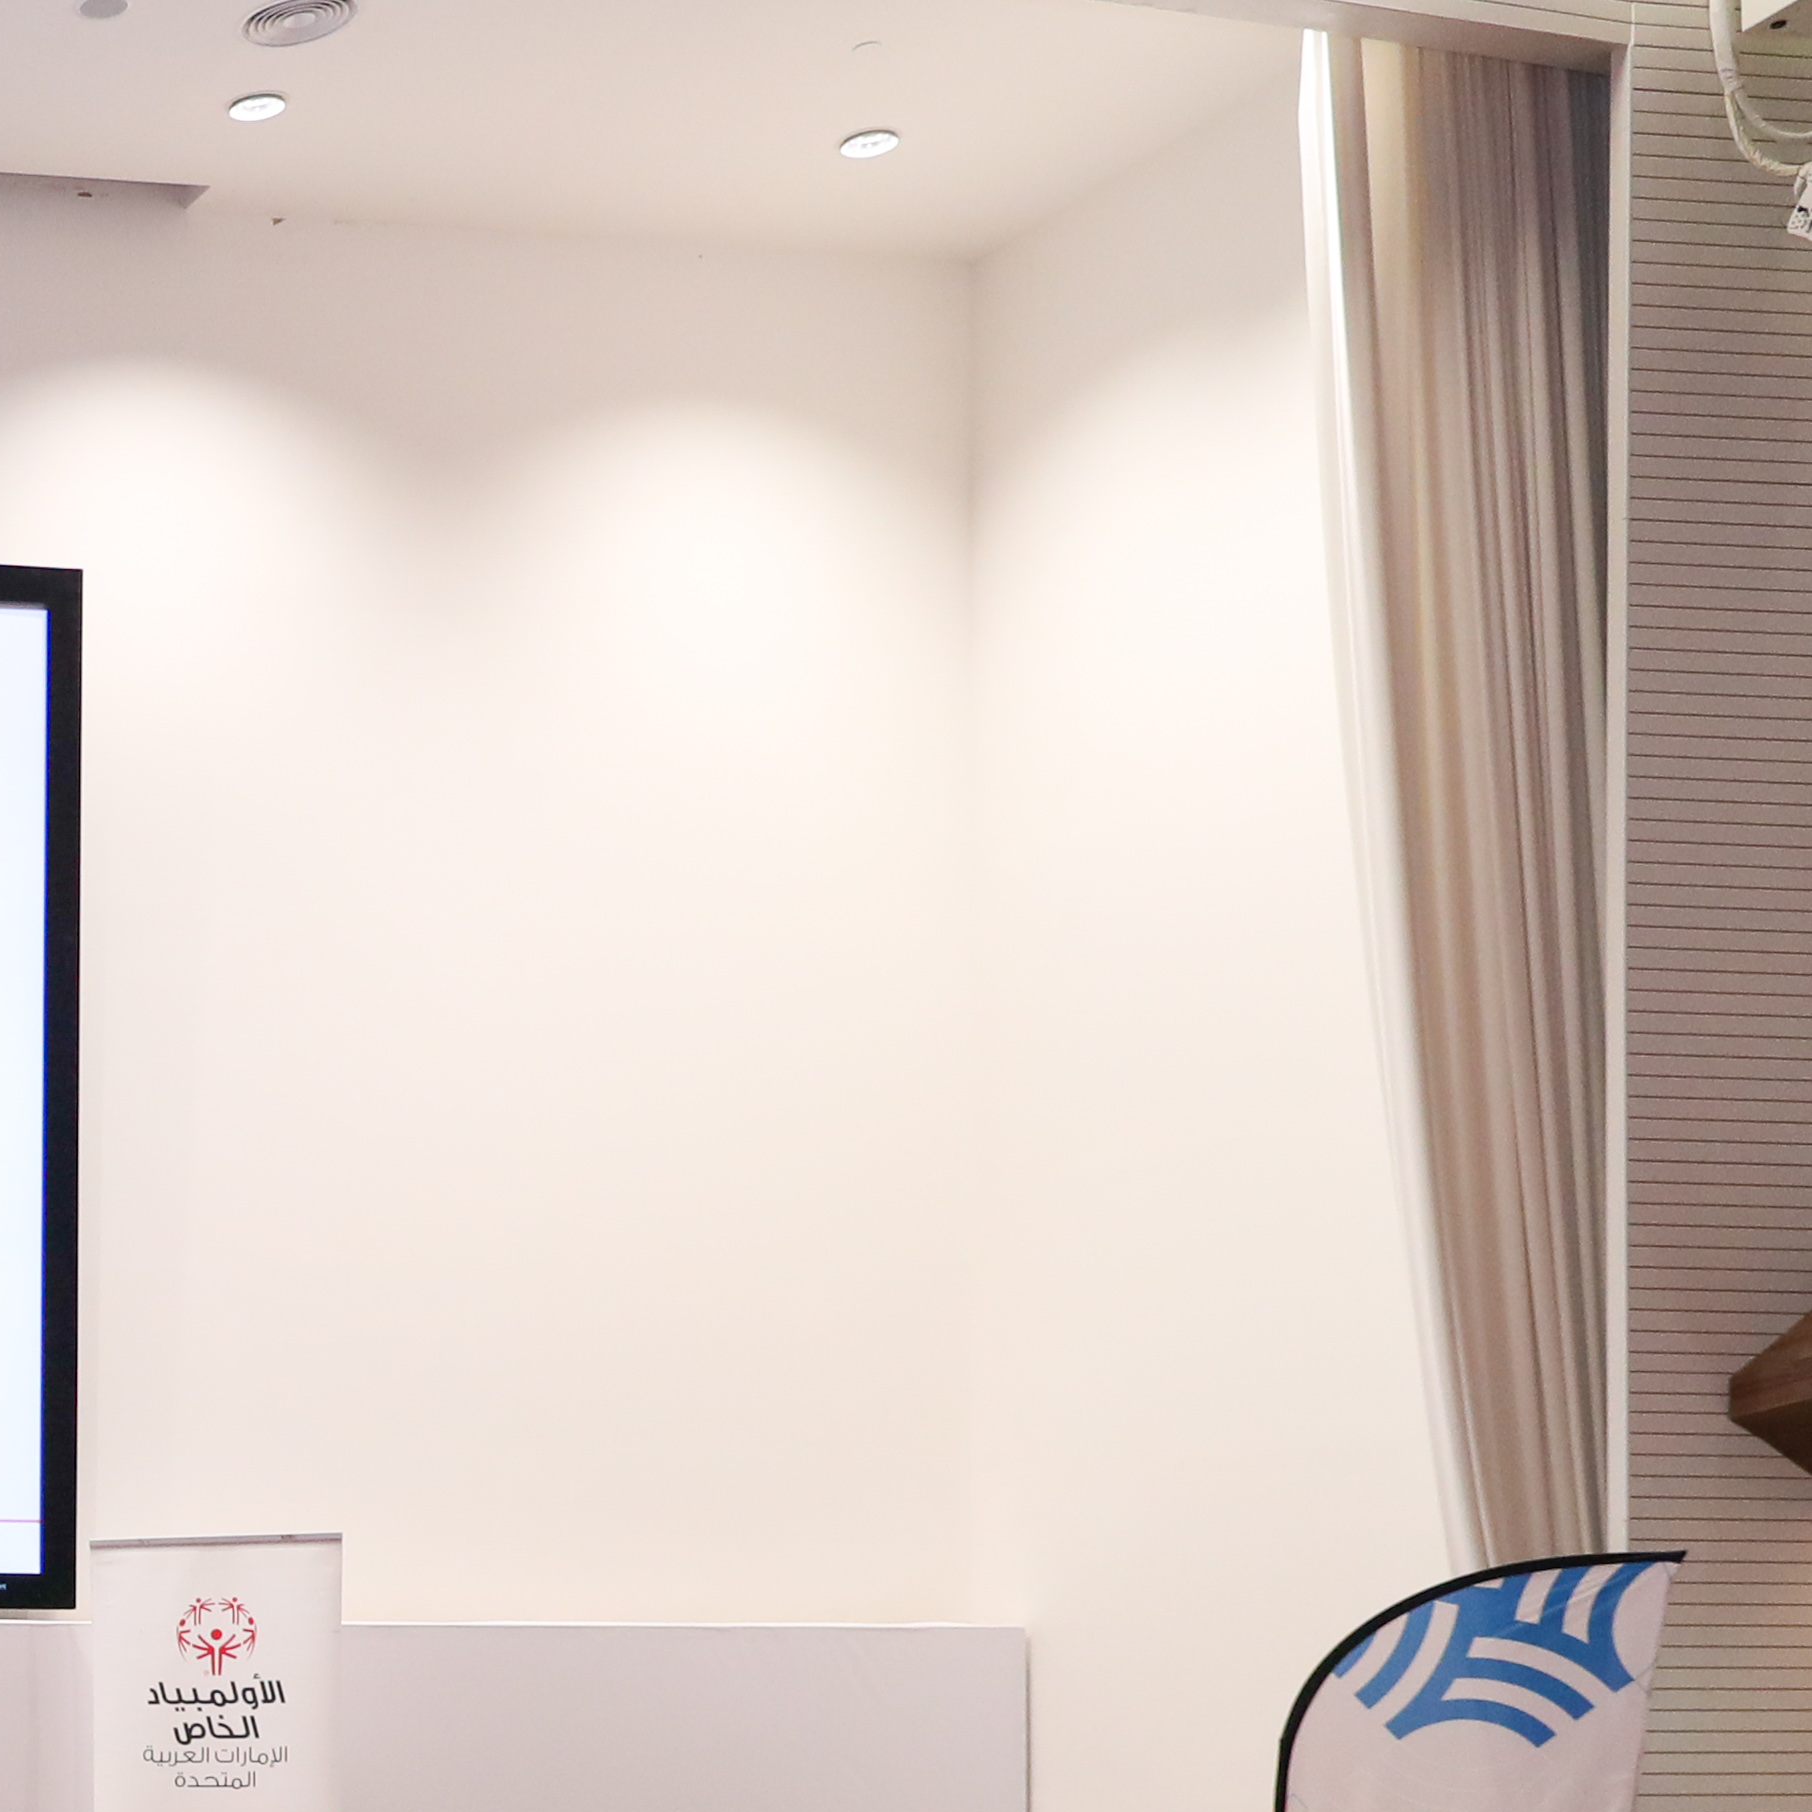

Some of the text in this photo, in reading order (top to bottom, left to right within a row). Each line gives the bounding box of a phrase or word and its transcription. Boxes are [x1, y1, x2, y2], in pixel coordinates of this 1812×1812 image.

[147, 1672, 286, 1711] الأولمبياد
[172, 1714, 260, 1746] الخاص
[142, 1744, 289, 1768] الإمارات العربية
[174, 1770, 257, 1790] المتحدة
